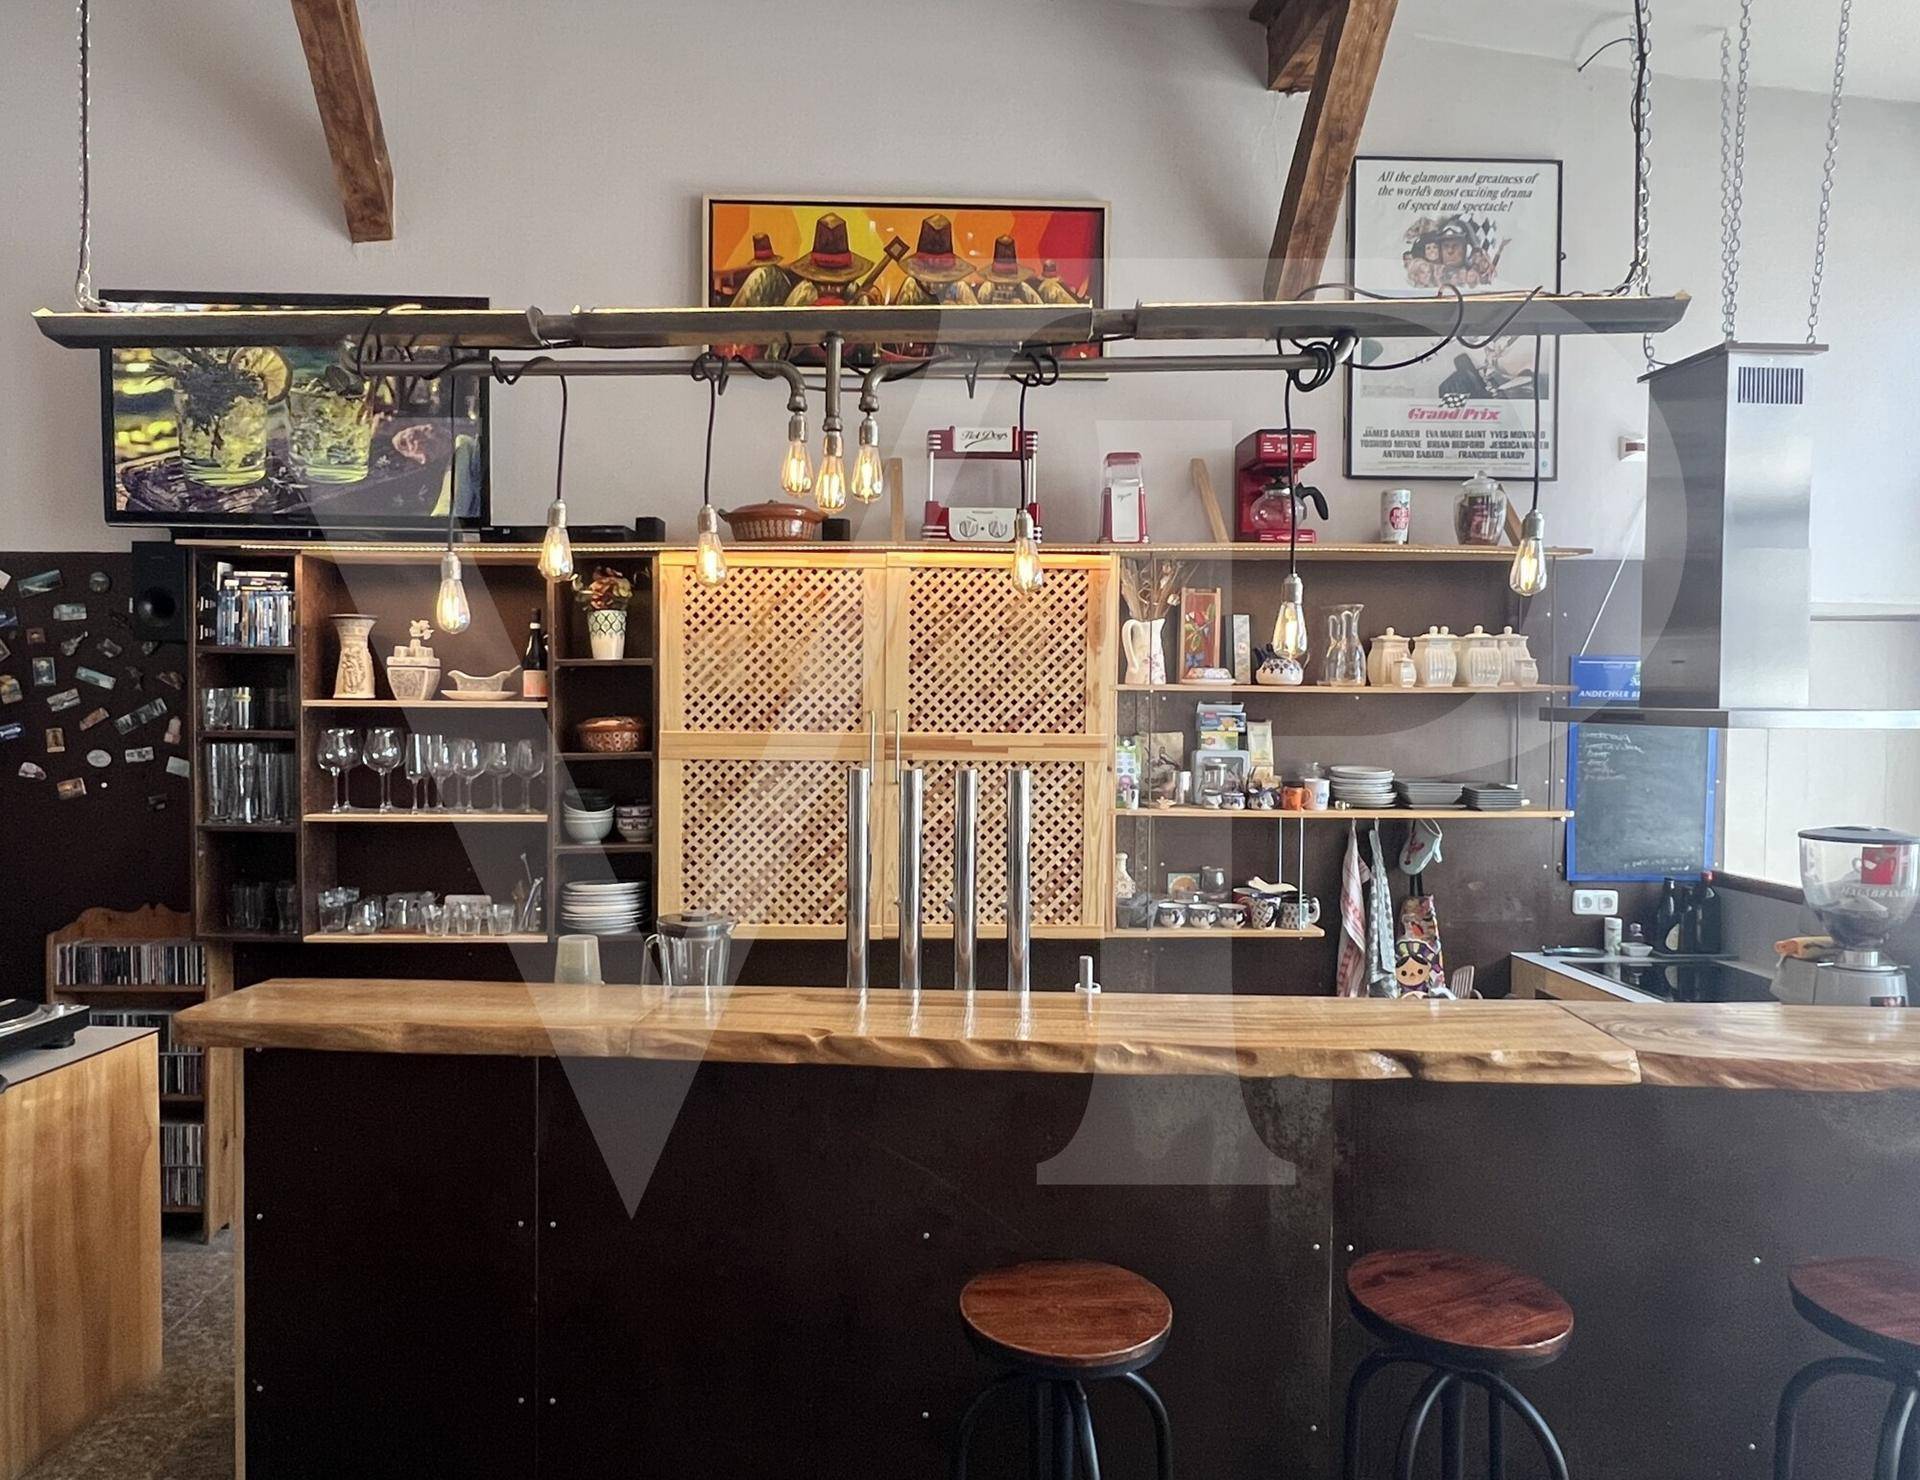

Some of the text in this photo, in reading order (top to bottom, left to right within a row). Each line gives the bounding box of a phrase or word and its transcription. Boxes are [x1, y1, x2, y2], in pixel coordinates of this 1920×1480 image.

[1378, 171, 1540, 185] All the glamour and greatness of
[1377, 185, 1533, 200] the world's most exciting drama
[1397, 199, 1514, 213] of speed and spectacle!
[1408, 408, 1501, 420] Grand Prix
[1363, 429, 1389, 438] JAMES
[1390, 429, 1420, 438] GARNER
[1425, 430, 1439, 438] EVA
[1440, 430, 1463, 439] MARIE
[1489, 430, 1509, 439] YVES
[1510, 431, 1546, 439] MONTAD
[1360, 440, 1549, 450] TOSHIRO MIFUNE BRIAN BEDFORD JESSICA WALER
[1383, 450, 1415, 458] ANTONIO
[1500, 451, 1526, 459] HARDY
[1578, 690, 1629, 698] ANDECHSER
